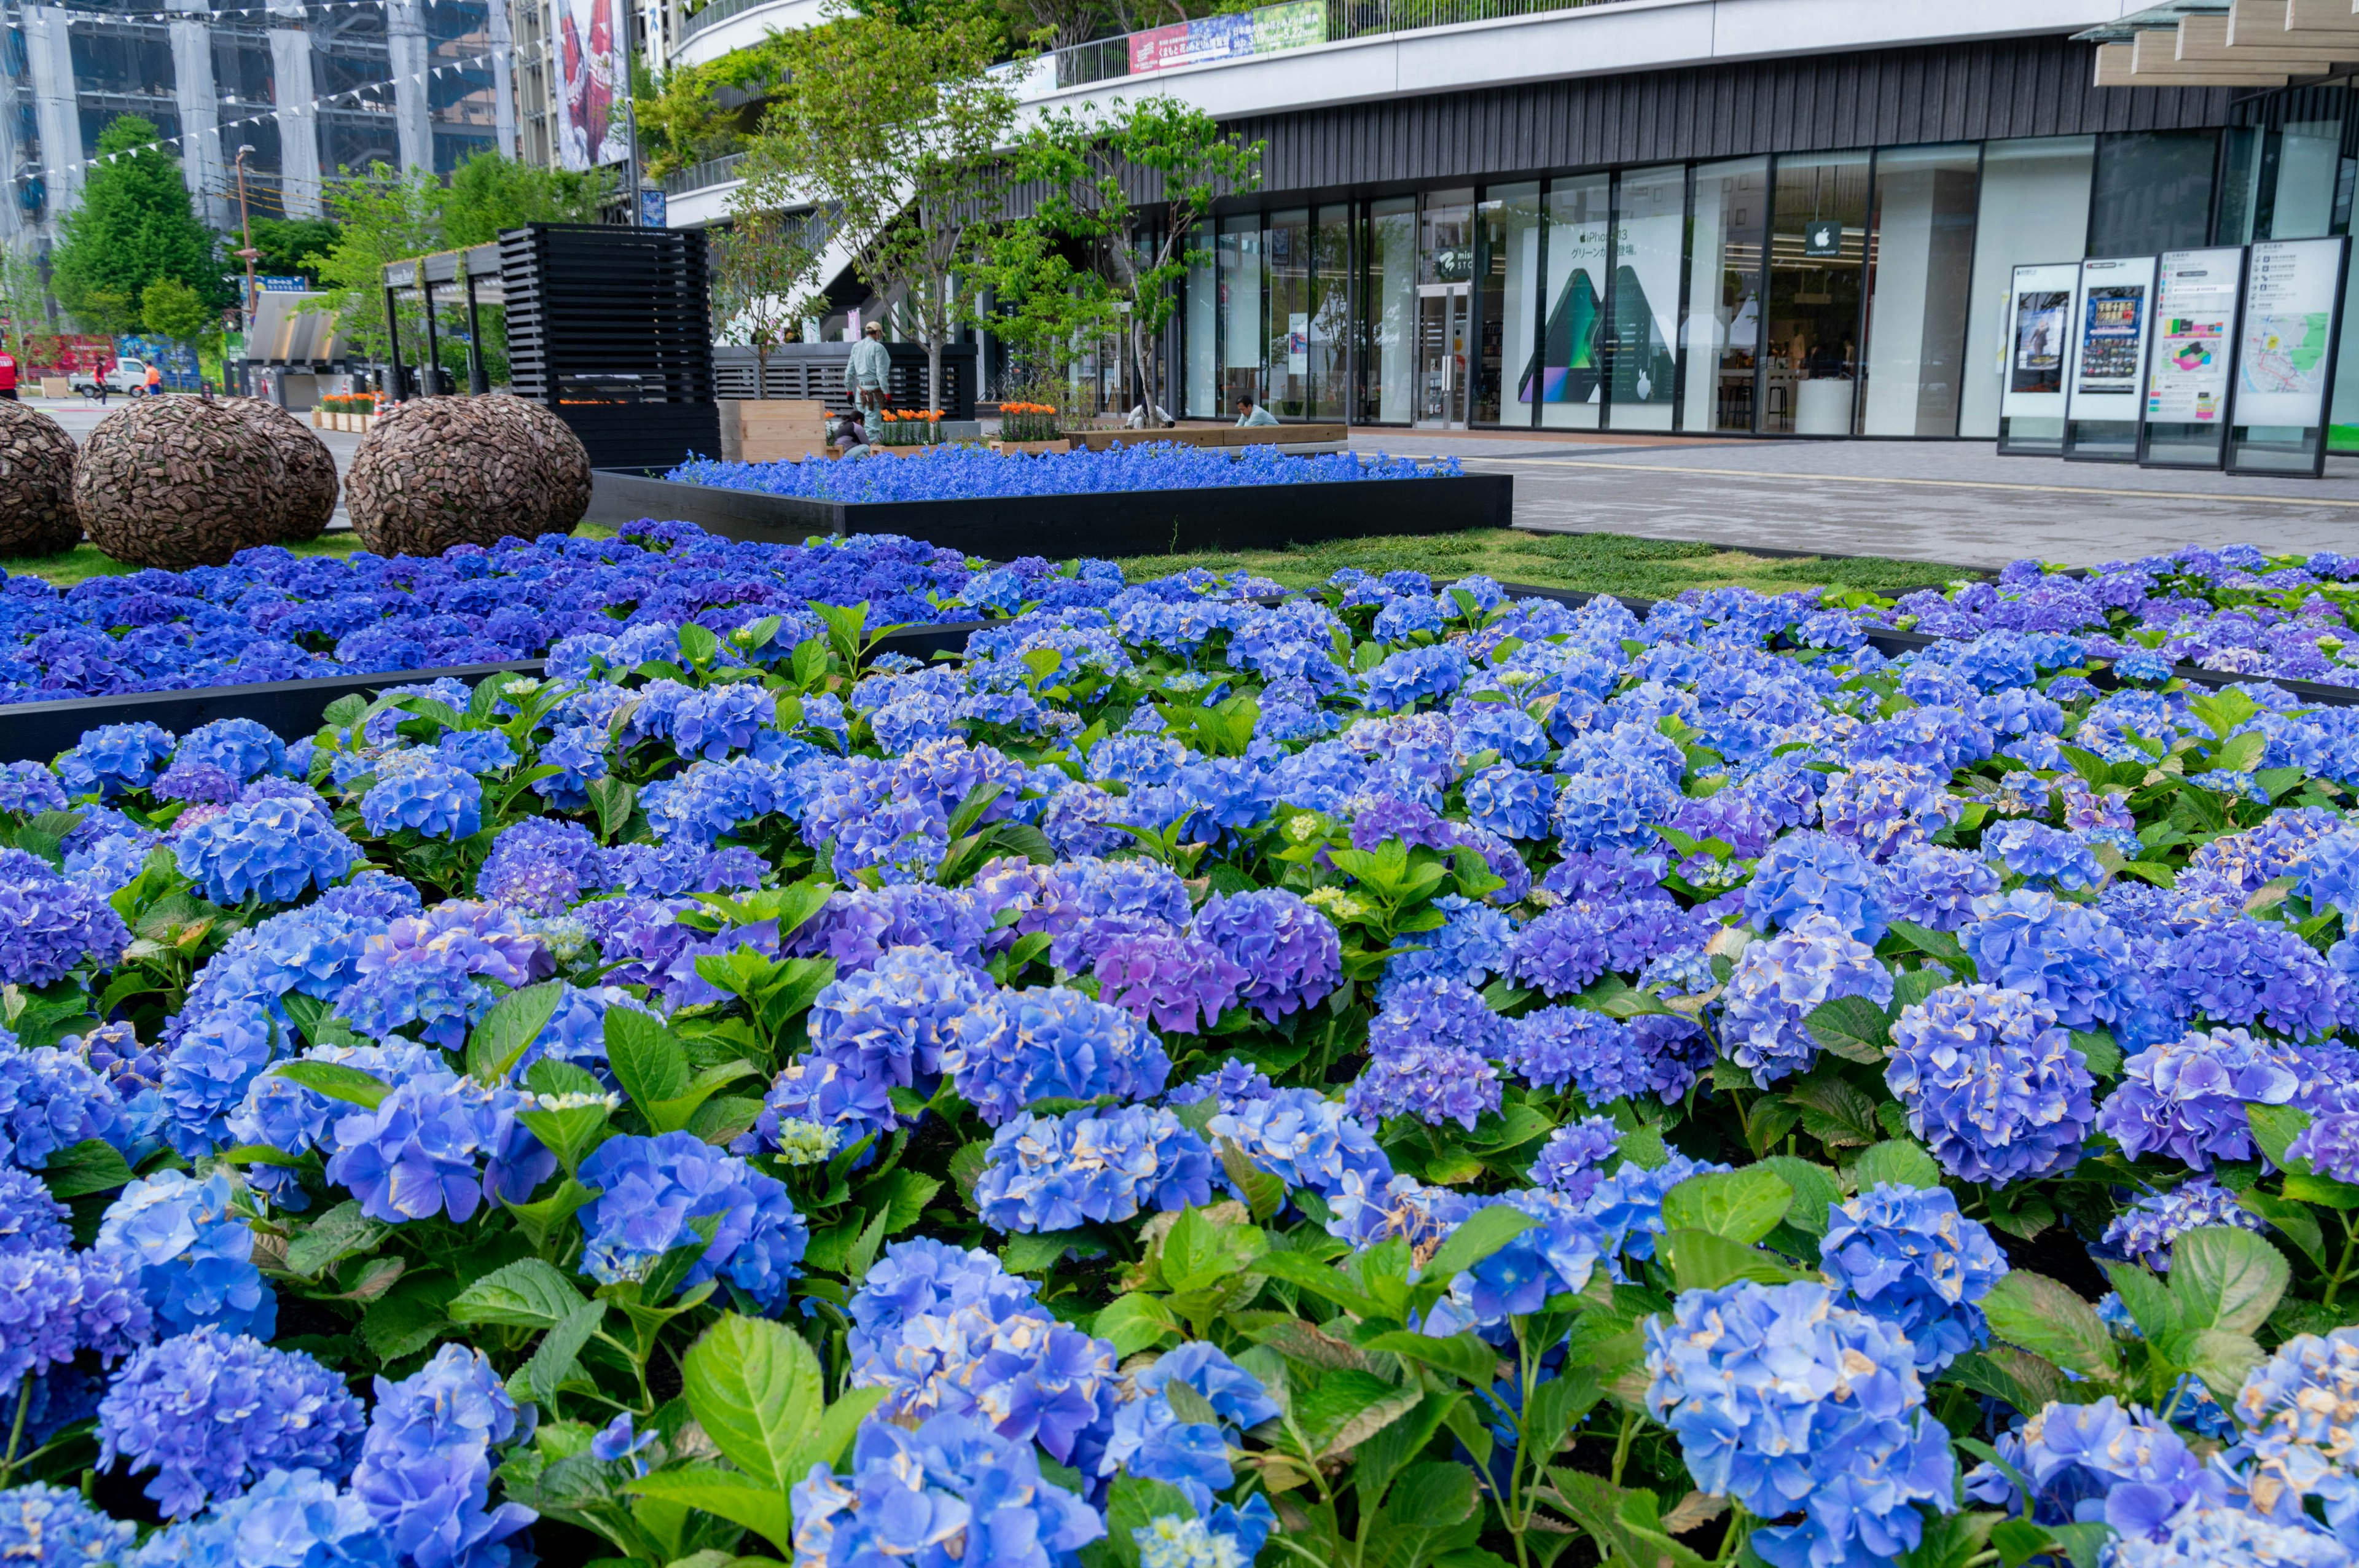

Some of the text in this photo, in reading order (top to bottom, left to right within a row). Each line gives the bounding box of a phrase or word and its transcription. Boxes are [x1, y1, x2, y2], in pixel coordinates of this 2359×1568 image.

[1159, 45, 1179, 57] くまもと
[1618, 229, 1627, 240] 13
